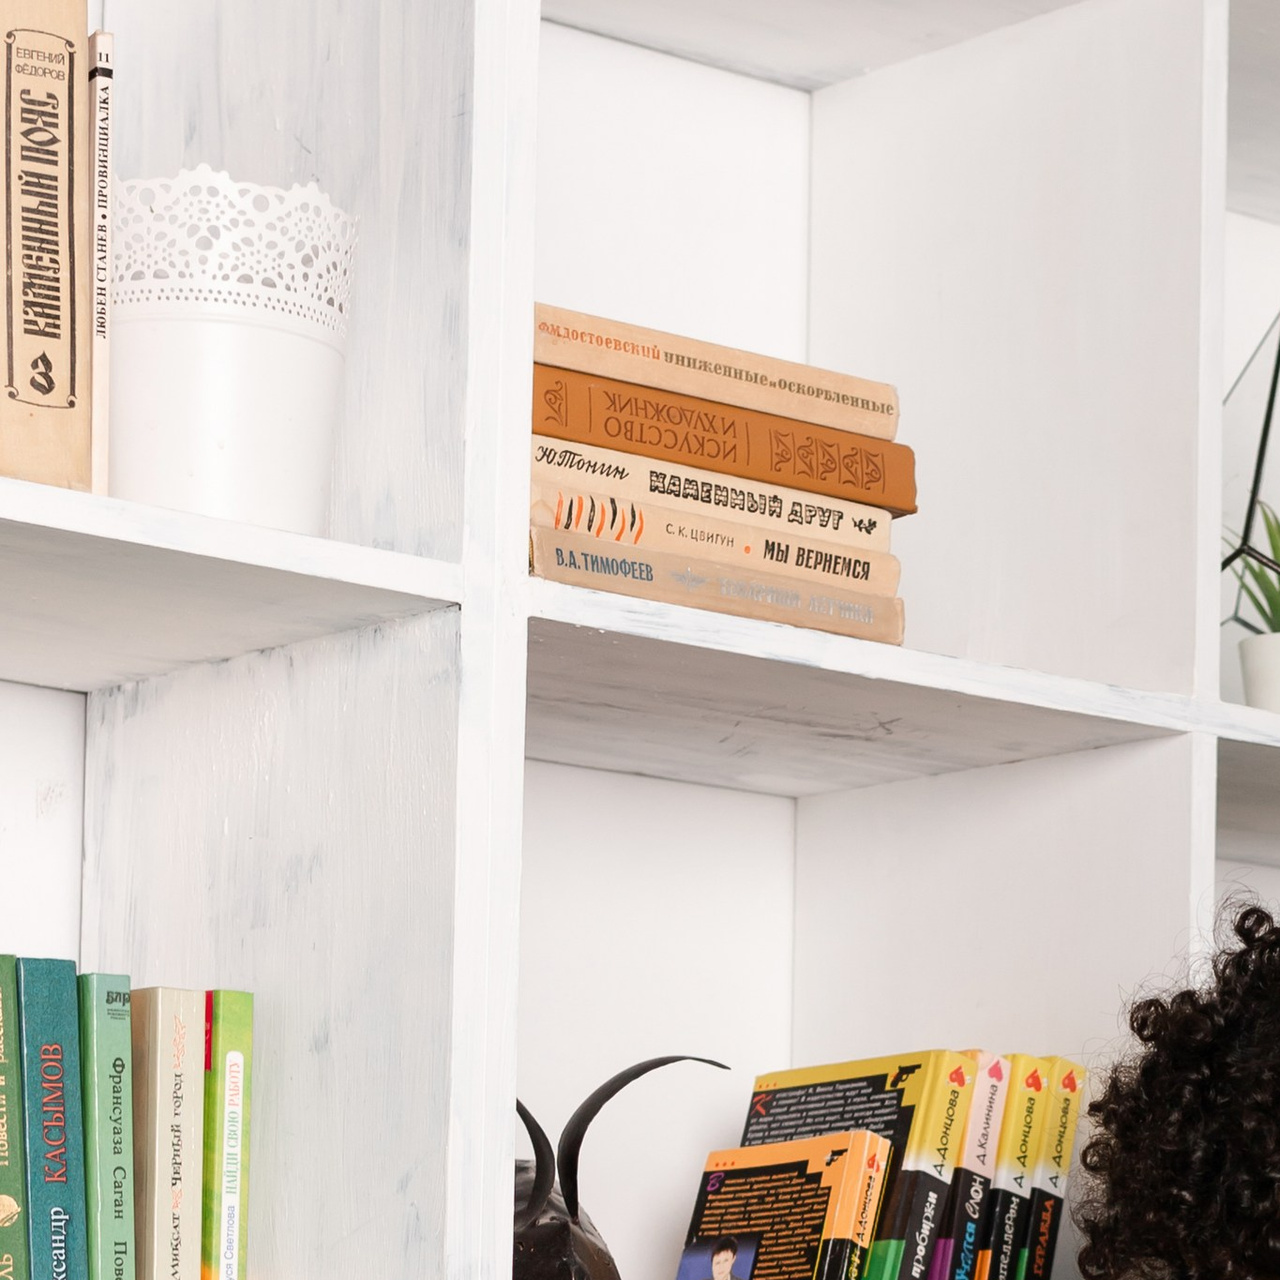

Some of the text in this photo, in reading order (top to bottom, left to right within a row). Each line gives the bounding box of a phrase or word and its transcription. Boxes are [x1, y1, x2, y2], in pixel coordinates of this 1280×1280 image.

[16, 47, 65, 66] ЕВГЕНИЙ
[97, 53, 111, 67] 11
[95, 86, 111, 340] ЛЮБЕН СТАНЕВ ПРОВИНЦИАЛКА
[602, 389, 721, 437] ХУДОЖНИК
[603, 414, 738, 463] ИСКУССТВО
[649, 470, 845, 532] КАМЕННЫЙ ДРУГ
[691, 529, 735, 549] ЦВИГУН
[763, 540, 789, 566] МЫ
[795, 547, 872, 583] ВЕРНЕМСЯ
[108, 1057, 126, 1156] Франсуаза
[228, 1061, 240, 1107] РАБОТУ
[40, 1043, 68, 1185] КАСЫМОВ
[227, 1110, 238, 1148] СВОЮ
[1016, 1096, 1037, 1168] Донцова
[1051, 1096, 1071, 1168] Донцова
[112, 1165, 127, 1220] Саган
[224, 1147, 238, 1196] НАЙДИ
[223, 1204, 236, 1261] Светлова
[911, 1191, 939, 1279] пробирки
